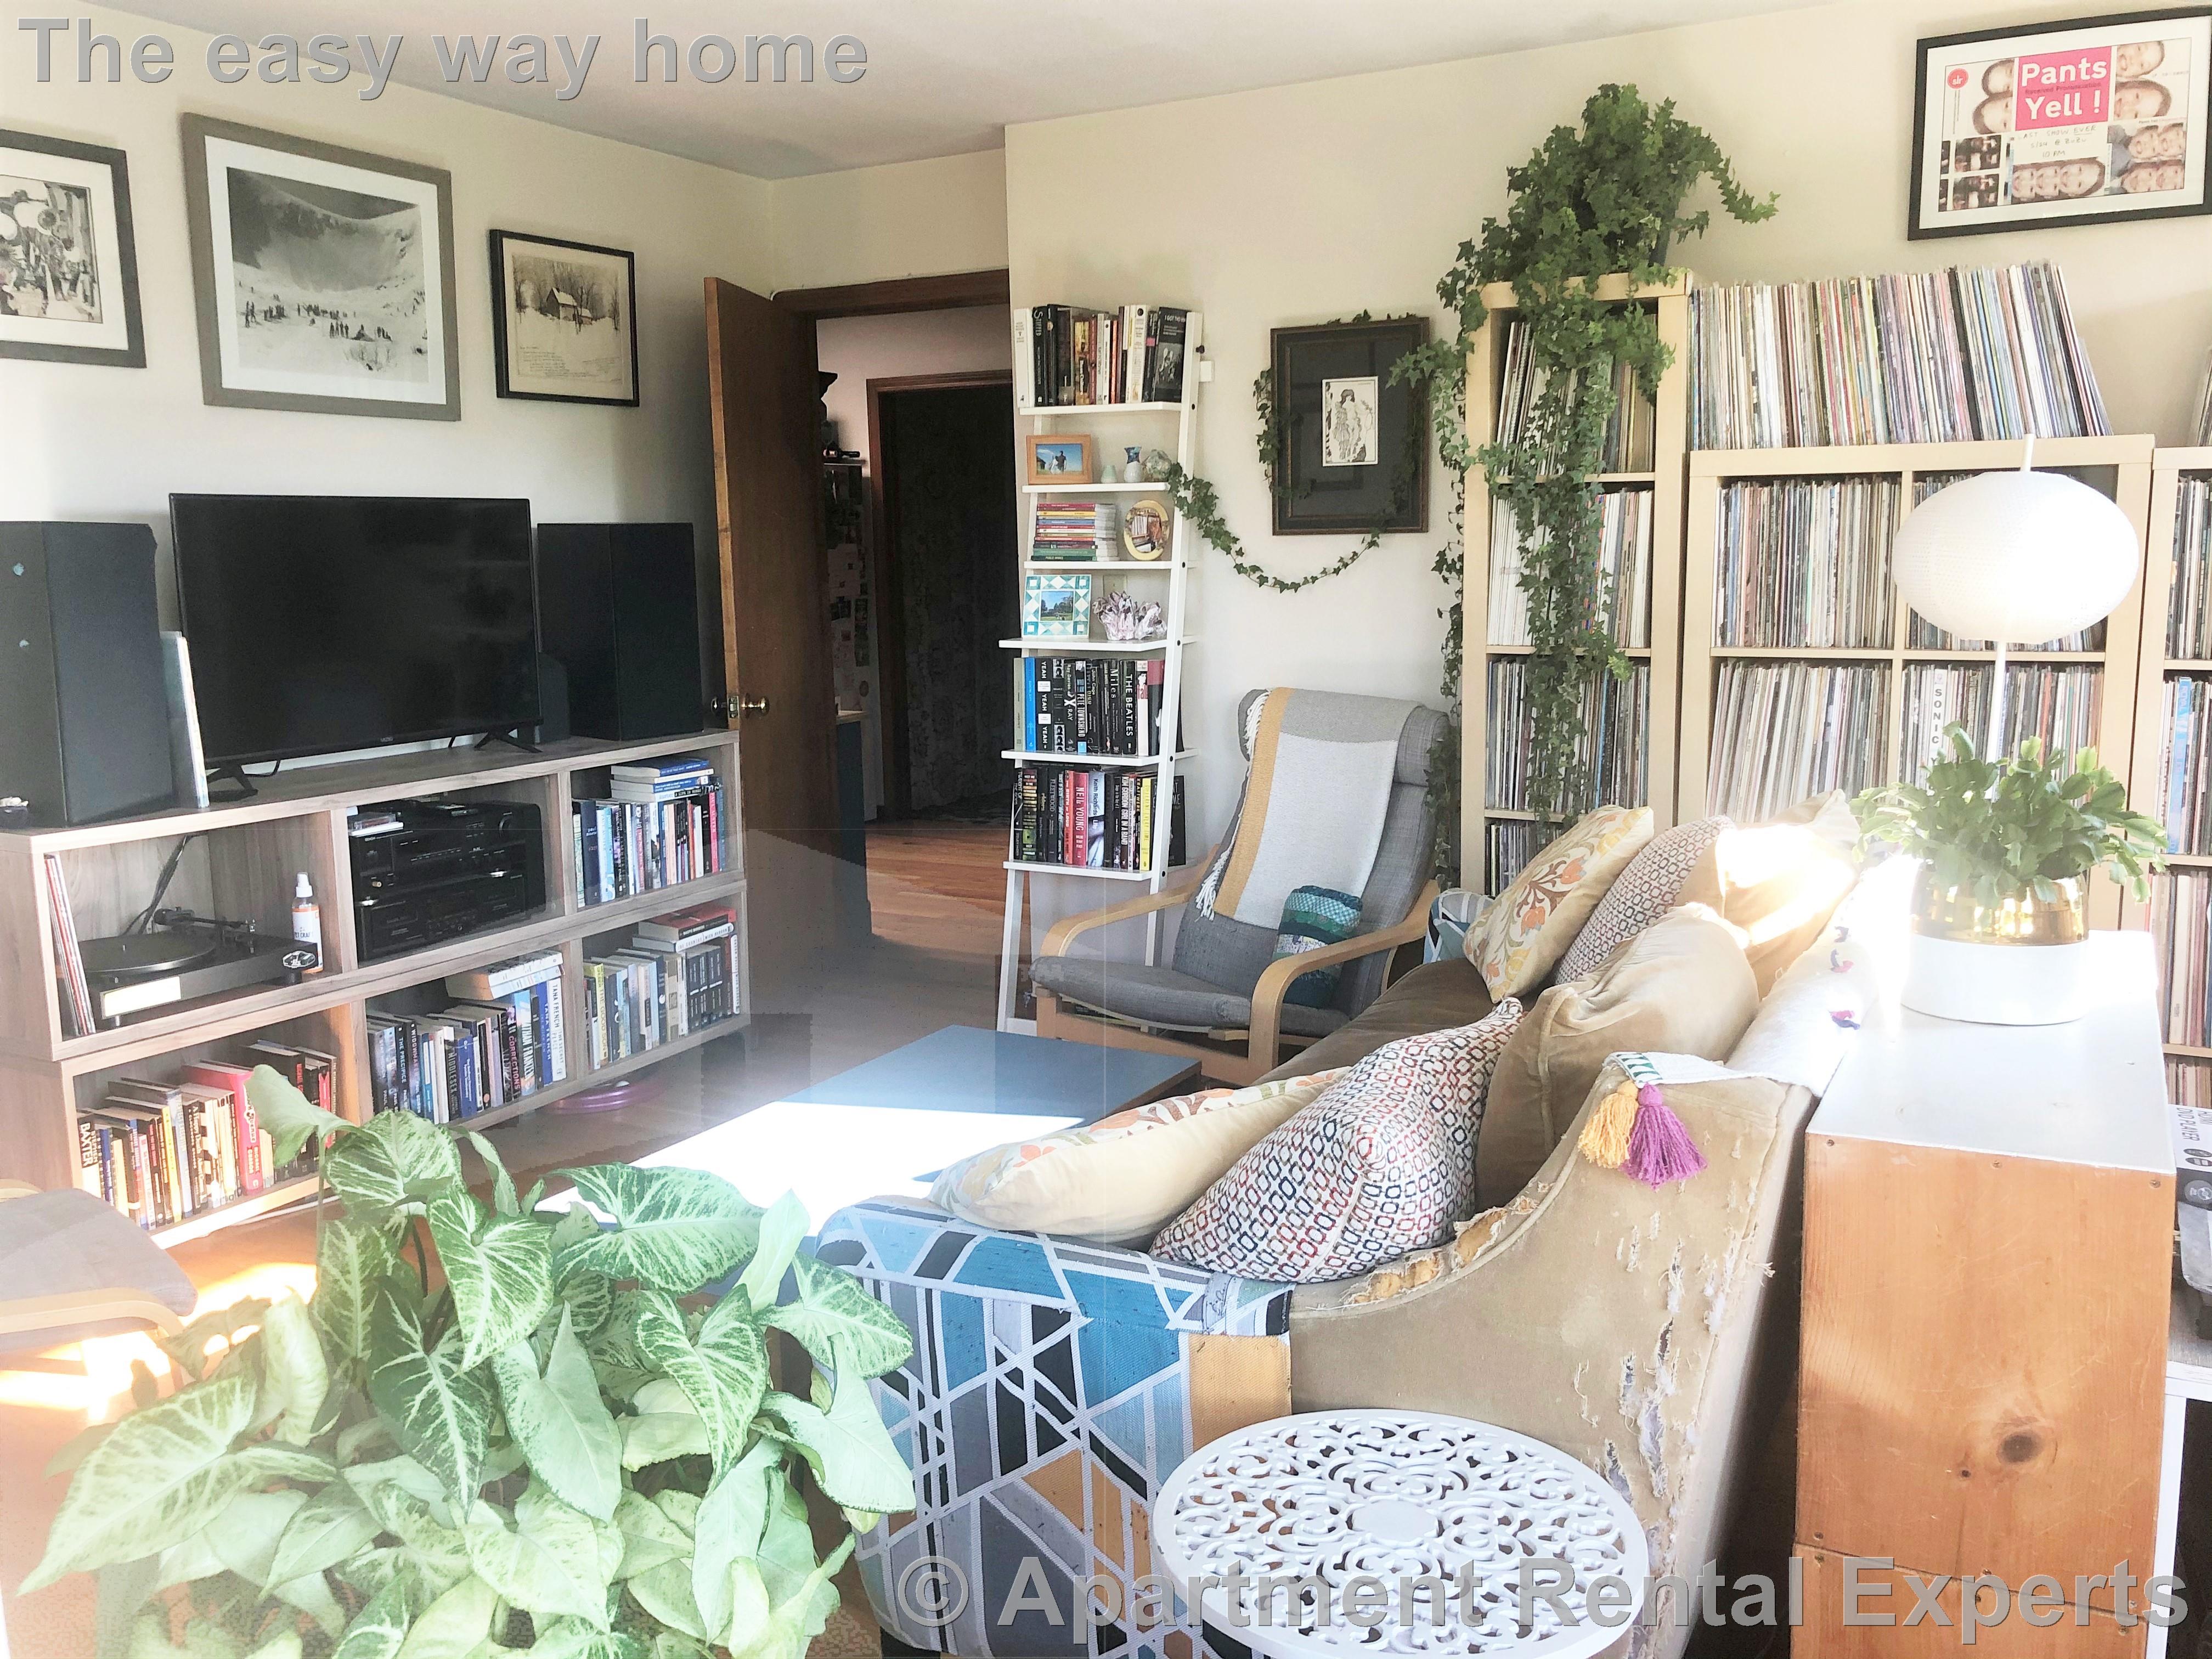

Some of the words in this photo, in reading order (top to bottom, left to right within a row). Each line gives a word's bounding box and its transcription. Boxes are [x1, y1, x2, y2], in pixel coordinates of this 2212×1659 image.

[2021, 58, 2107, 88] Pants
[2025, 90, 2083, 120] Yell
[1110, 669, 1119, 698] Miles
[1075, 787, 1085, 804] NEIL
[1075, 807, 1084, 831] YOUNG
[448, 1052, 457, 1093] MIDDLESEX
[509, 1036, 520, 1090] CORRECTIONS
[523, 1046, 534, 1079] FRANZEN
[2176, 1108, 2194, 1119] DVD
[80, 1122, 93, 1166] BAXTER
[2179, 1119, 2200, 1141] PLAYER
